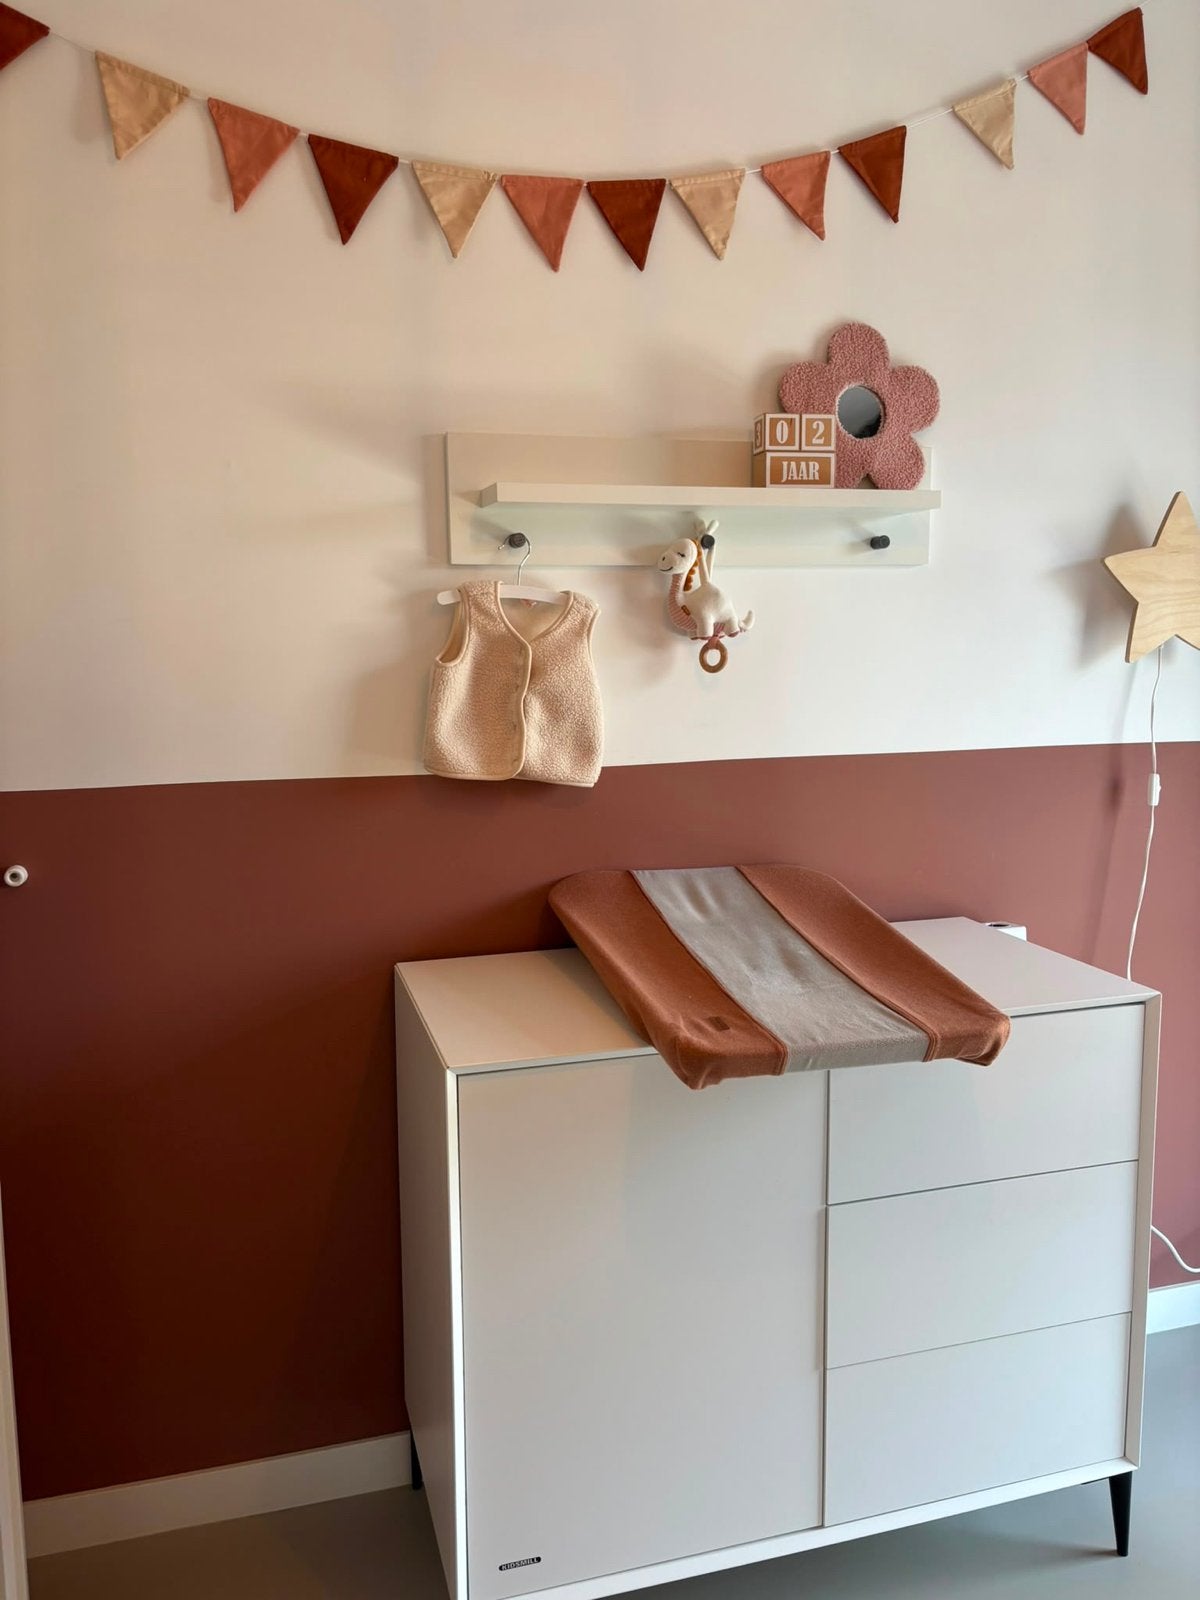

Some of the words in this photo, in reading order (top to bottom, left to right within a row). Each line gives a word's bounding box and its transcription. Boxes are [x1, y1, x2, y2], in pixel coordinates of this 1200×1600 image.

[776, 420, 789, 444] 0
[812, 420, 825, 445] 2
[781, 461, 820, 483] JAAR
[501, 1557, 538, 1570] KIDSMILL
